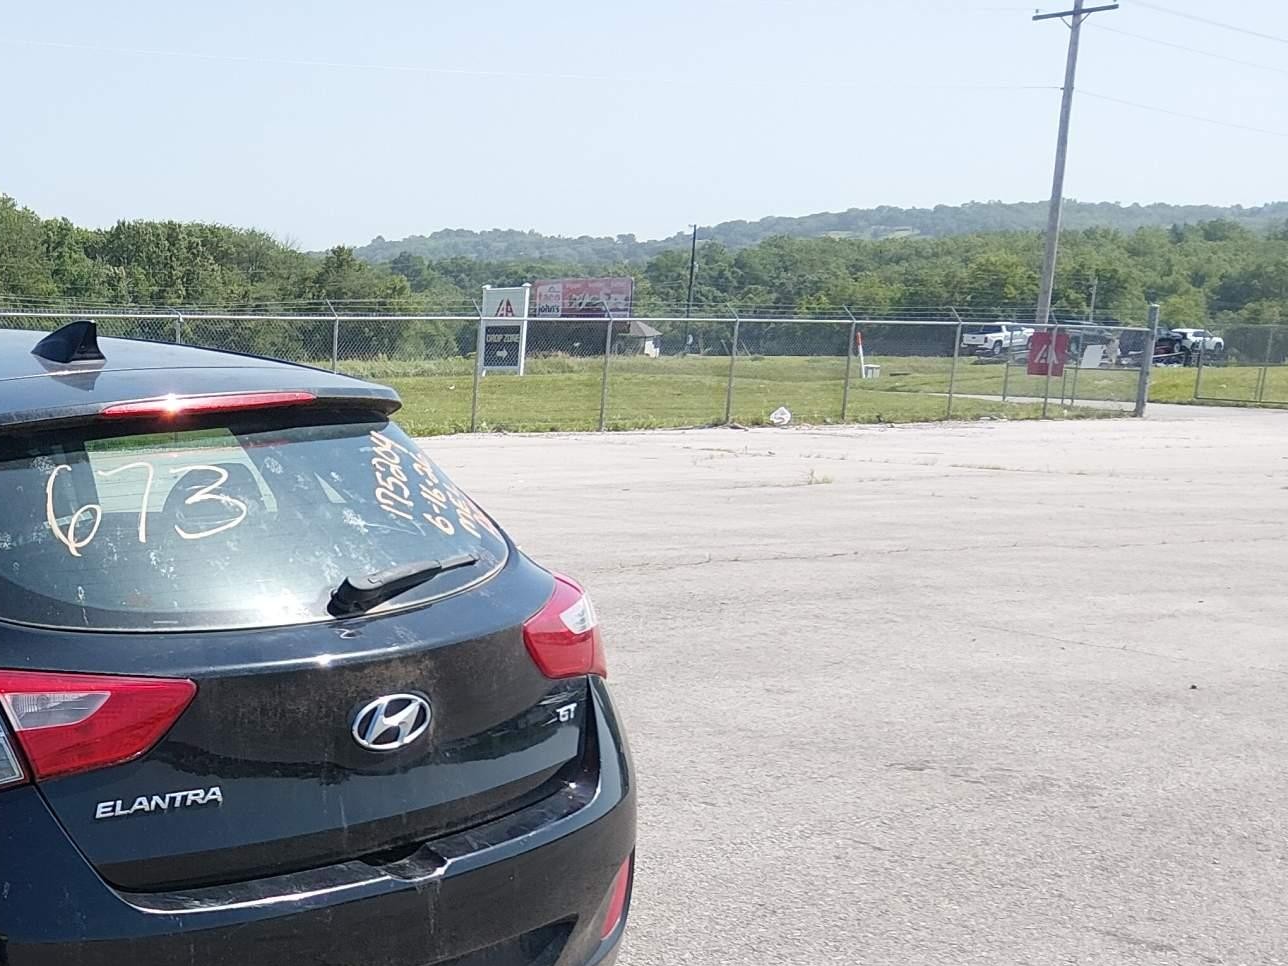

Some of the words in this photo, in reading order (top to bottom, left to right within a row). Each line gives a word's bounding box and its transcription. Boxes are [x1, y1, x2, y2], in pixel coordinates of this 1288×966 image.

[538, 304, 560, 314] john's
[487, 334, 502, 343] DROP
[503, 333, 520, 343] ZONE
[370, 430, 414, 520] 175204
[46, 461, 248, 557] 673
[556, 702, 578, 722] GT
[95, 786, 223, 819] ELANTRA
